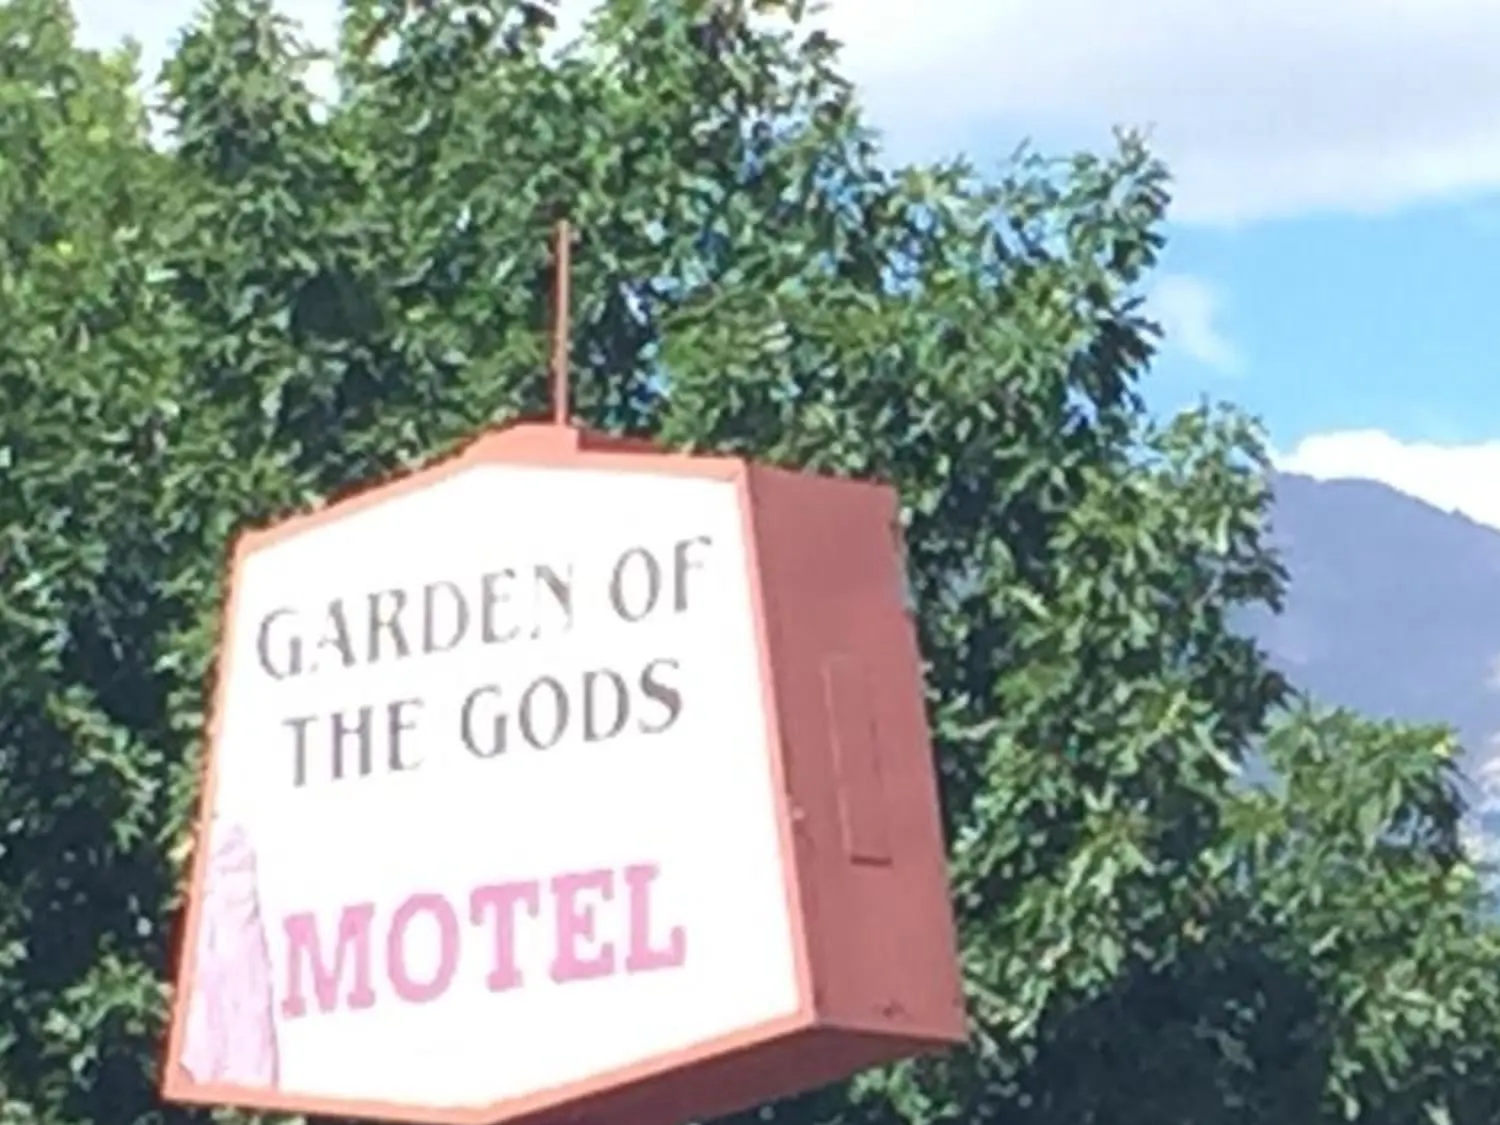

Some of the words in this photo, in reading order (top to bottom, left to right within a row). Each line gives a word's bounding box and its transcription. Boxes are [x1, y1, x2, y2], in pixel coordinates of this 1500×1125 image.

[256, 563, 574, 680] GARDEN
[608, 535, 714, 623] OF
[281, 699, 426, 788] THE
[459, 658, 684, 760] GODS
[280, 862, 687, 1018] MOTEL
